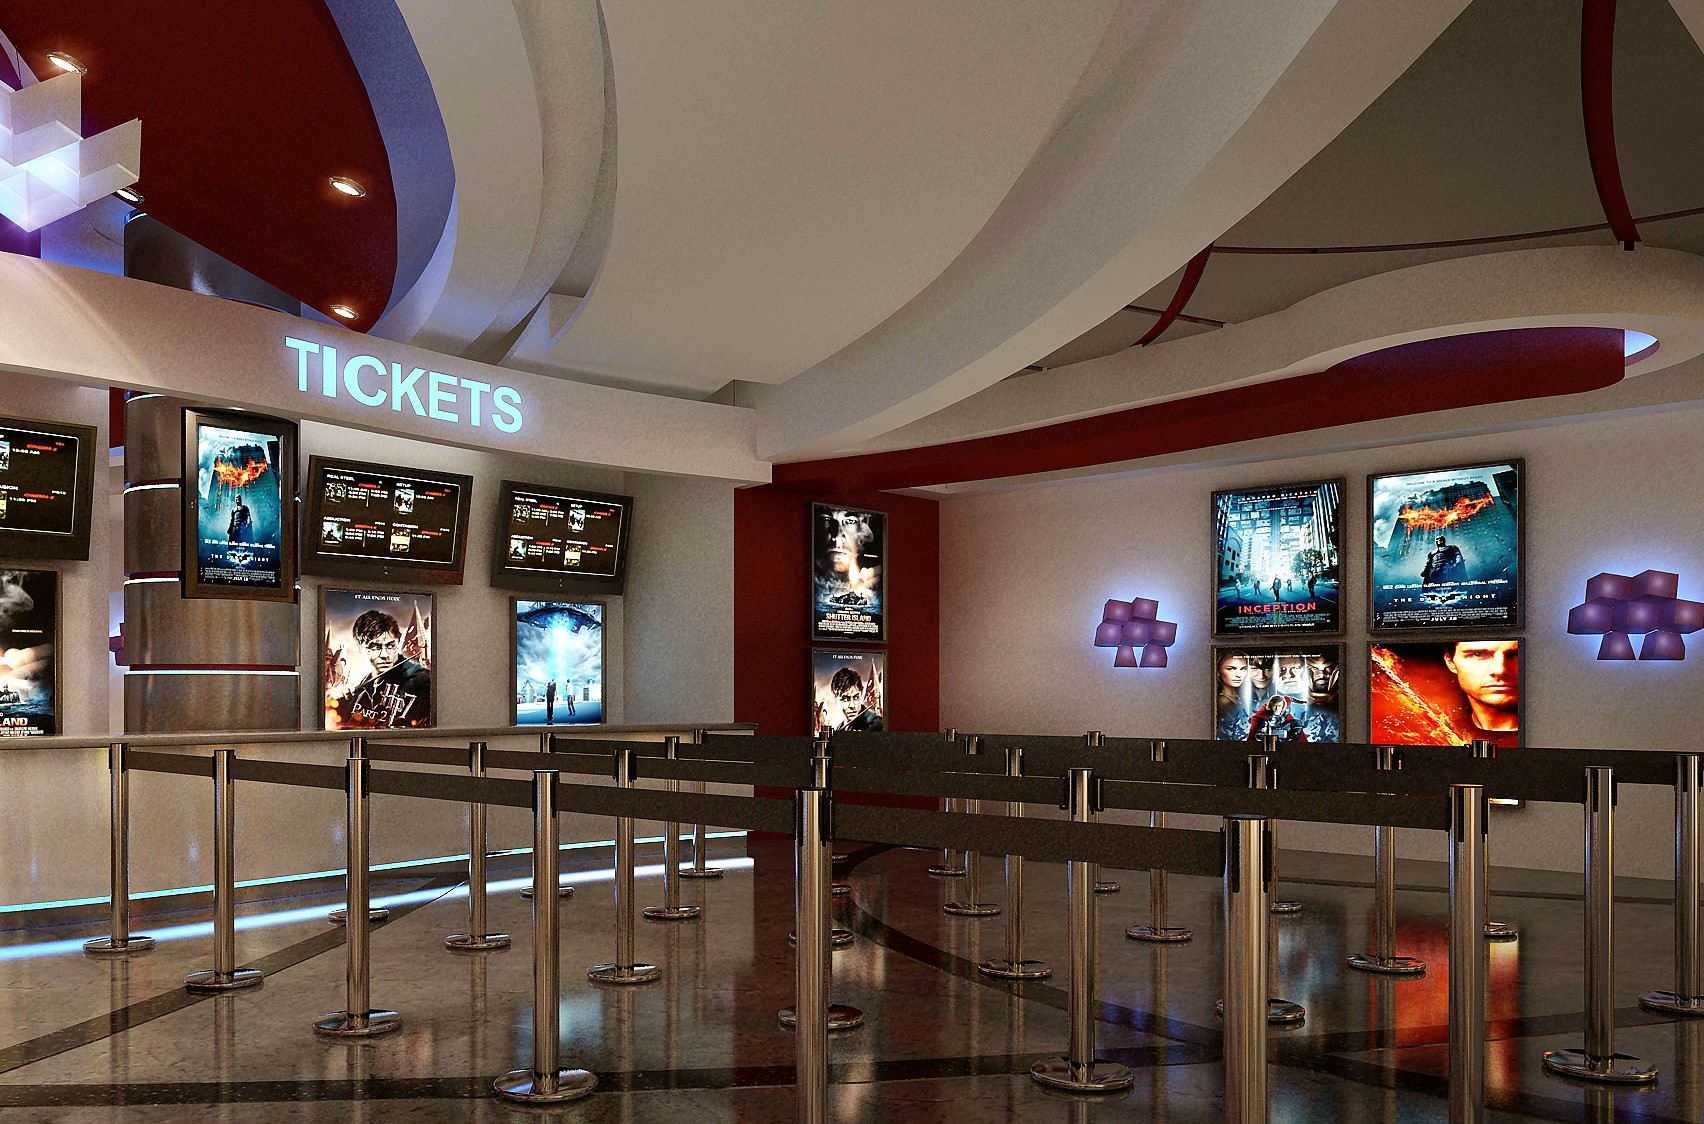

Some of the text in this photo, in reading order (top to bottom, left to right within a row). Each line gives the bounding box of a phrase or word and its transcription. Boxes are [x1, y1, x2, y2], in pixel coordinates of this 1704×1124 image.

[285, 336, 524, 433] TICKETS
[1238, 602, 1316, 614] INCEPTION
[826, 612, 872, 622] SHUTTER ISLAND
[351, 703, 388, 722] PART 2
